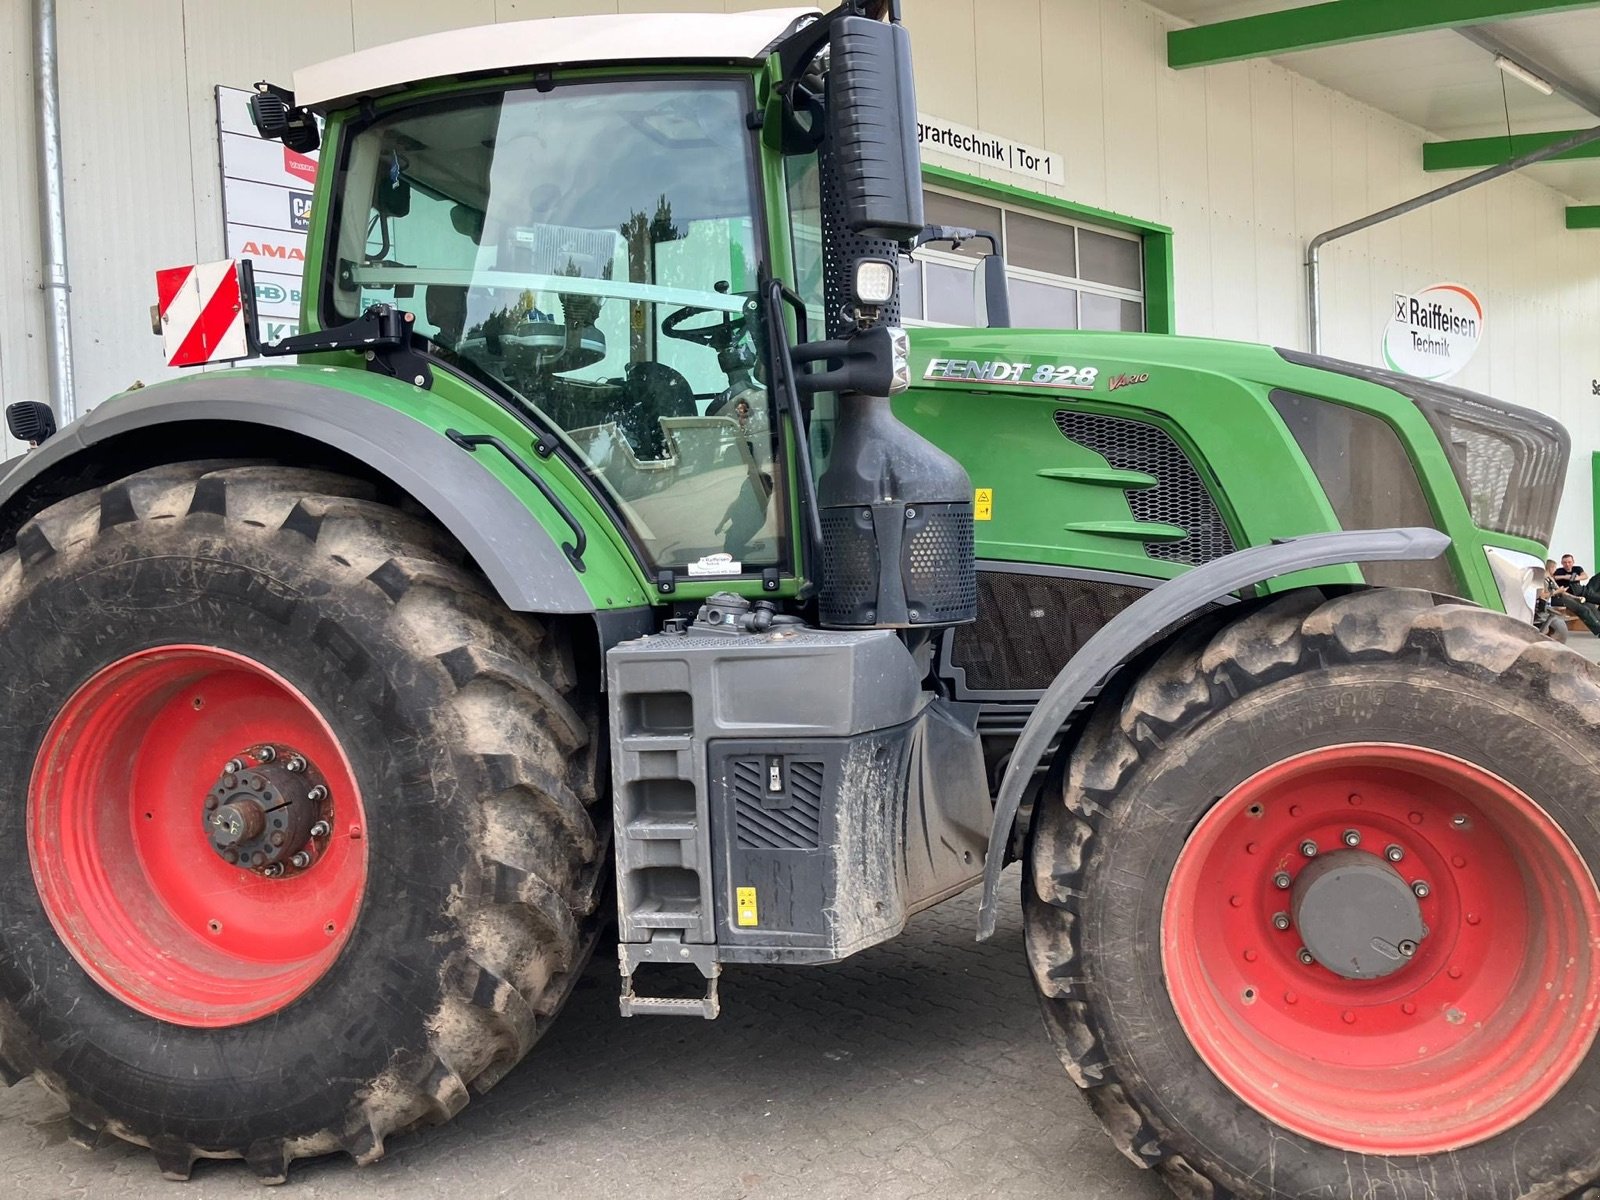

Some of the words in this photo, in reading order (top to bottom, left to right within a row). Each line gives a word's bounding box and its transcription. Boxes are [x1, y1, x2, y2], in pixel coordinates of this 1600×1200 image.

[1017, 148, 1040, 171] Tor
[1045, 157, 1051, 174] 1
[1410, 298, 1476, 338] Raiffeisen
[1411, 331, 1450, 357] Technik
[924, 358, 1031, 381] FENDT
[1032, 364, 1099, 385] 828
